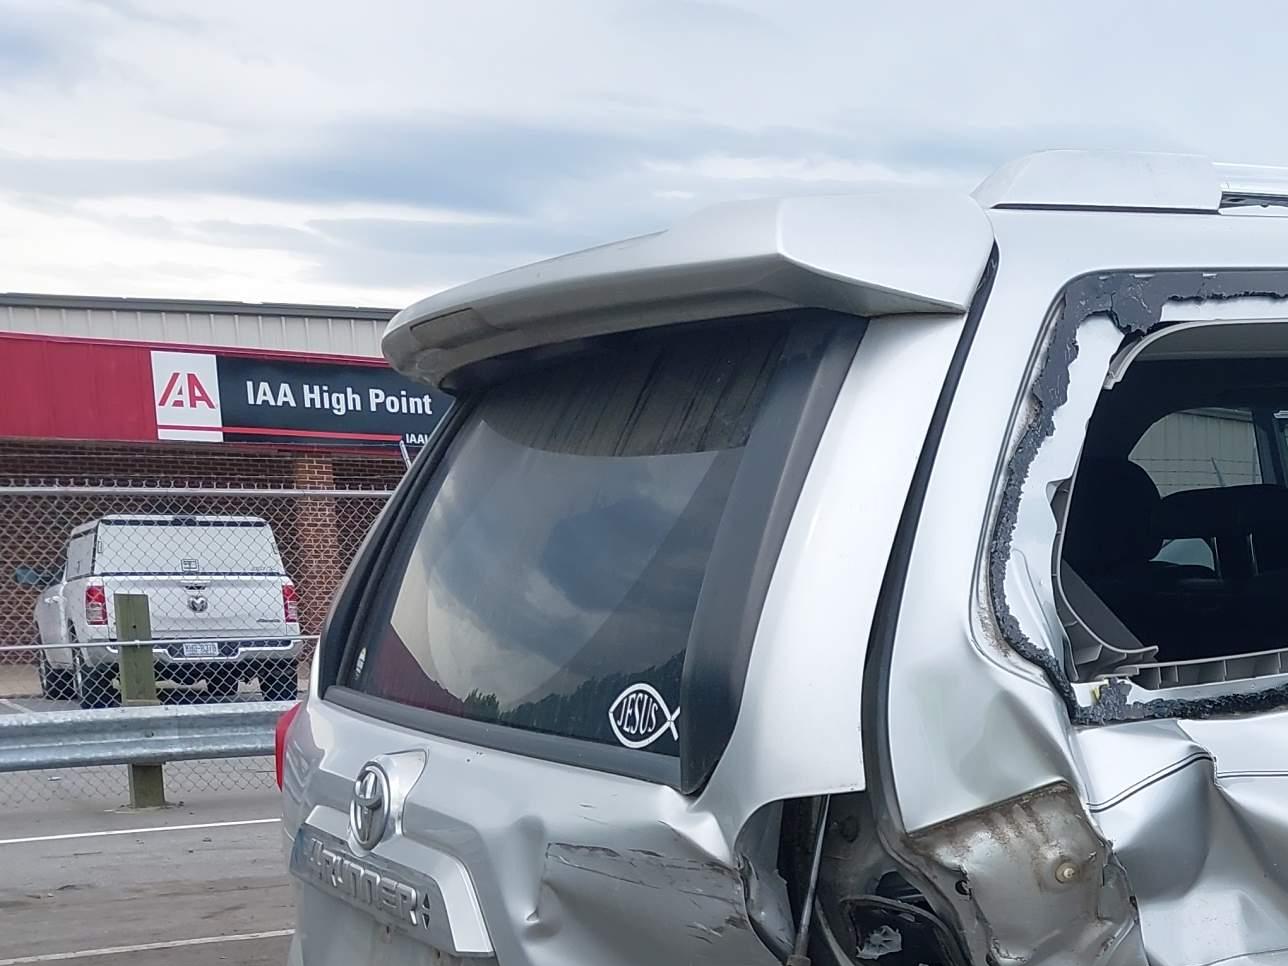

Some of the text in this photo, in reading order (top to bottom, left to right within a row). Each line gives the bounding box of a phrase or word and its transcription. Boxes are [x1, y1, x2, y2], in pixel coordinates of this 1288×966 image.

[246, 380, 433, 416] IAA High Point
[617, 692, 659, 735] JESUS
[310, 838, 419, 926] 4RUNNER
